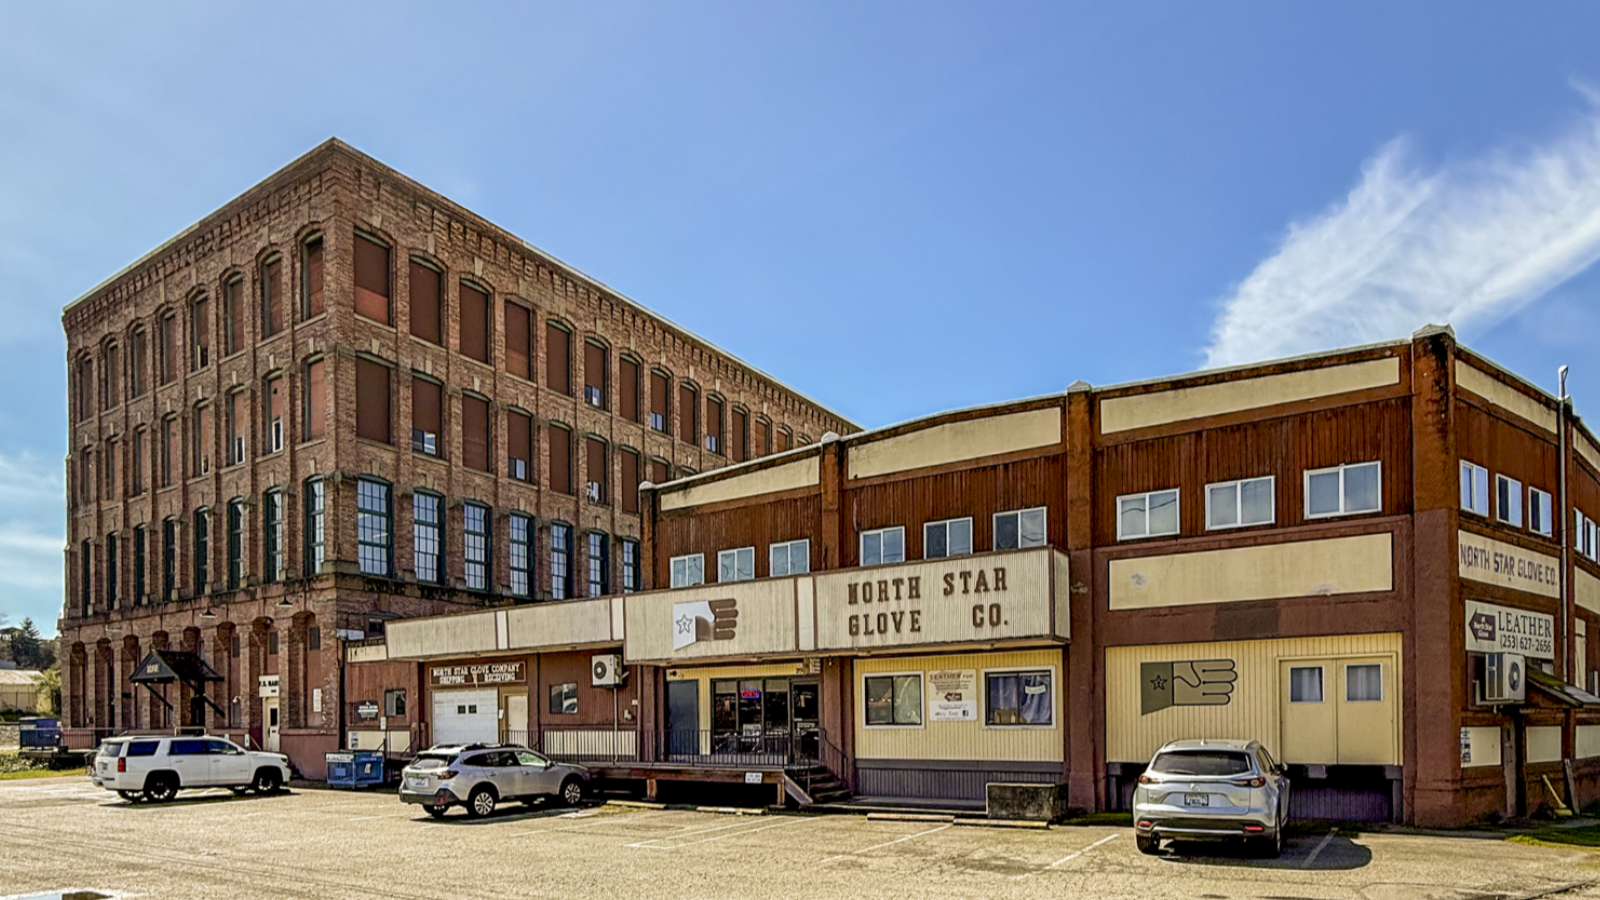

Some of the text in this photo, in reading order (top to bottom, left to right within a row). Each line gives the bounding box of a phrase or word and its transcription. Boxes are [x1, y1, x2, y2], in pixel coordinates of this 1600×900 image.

[1460, 544, 1557, 587] NORTH STAR GLOVE CO.
[848, 567, 1007, 605] NORTH STAR
[848, 603, 1009, 636] GLOVE CO.
[1498, 611, 1552, 638] LEATHER
[1500, 634, 1552, 653] (253) 627-2656
[433, 663, 520, 677] NORTH STAR GLOVE COMPANY
[440, 673, 516, 684] SHIPPING RECEIVING
